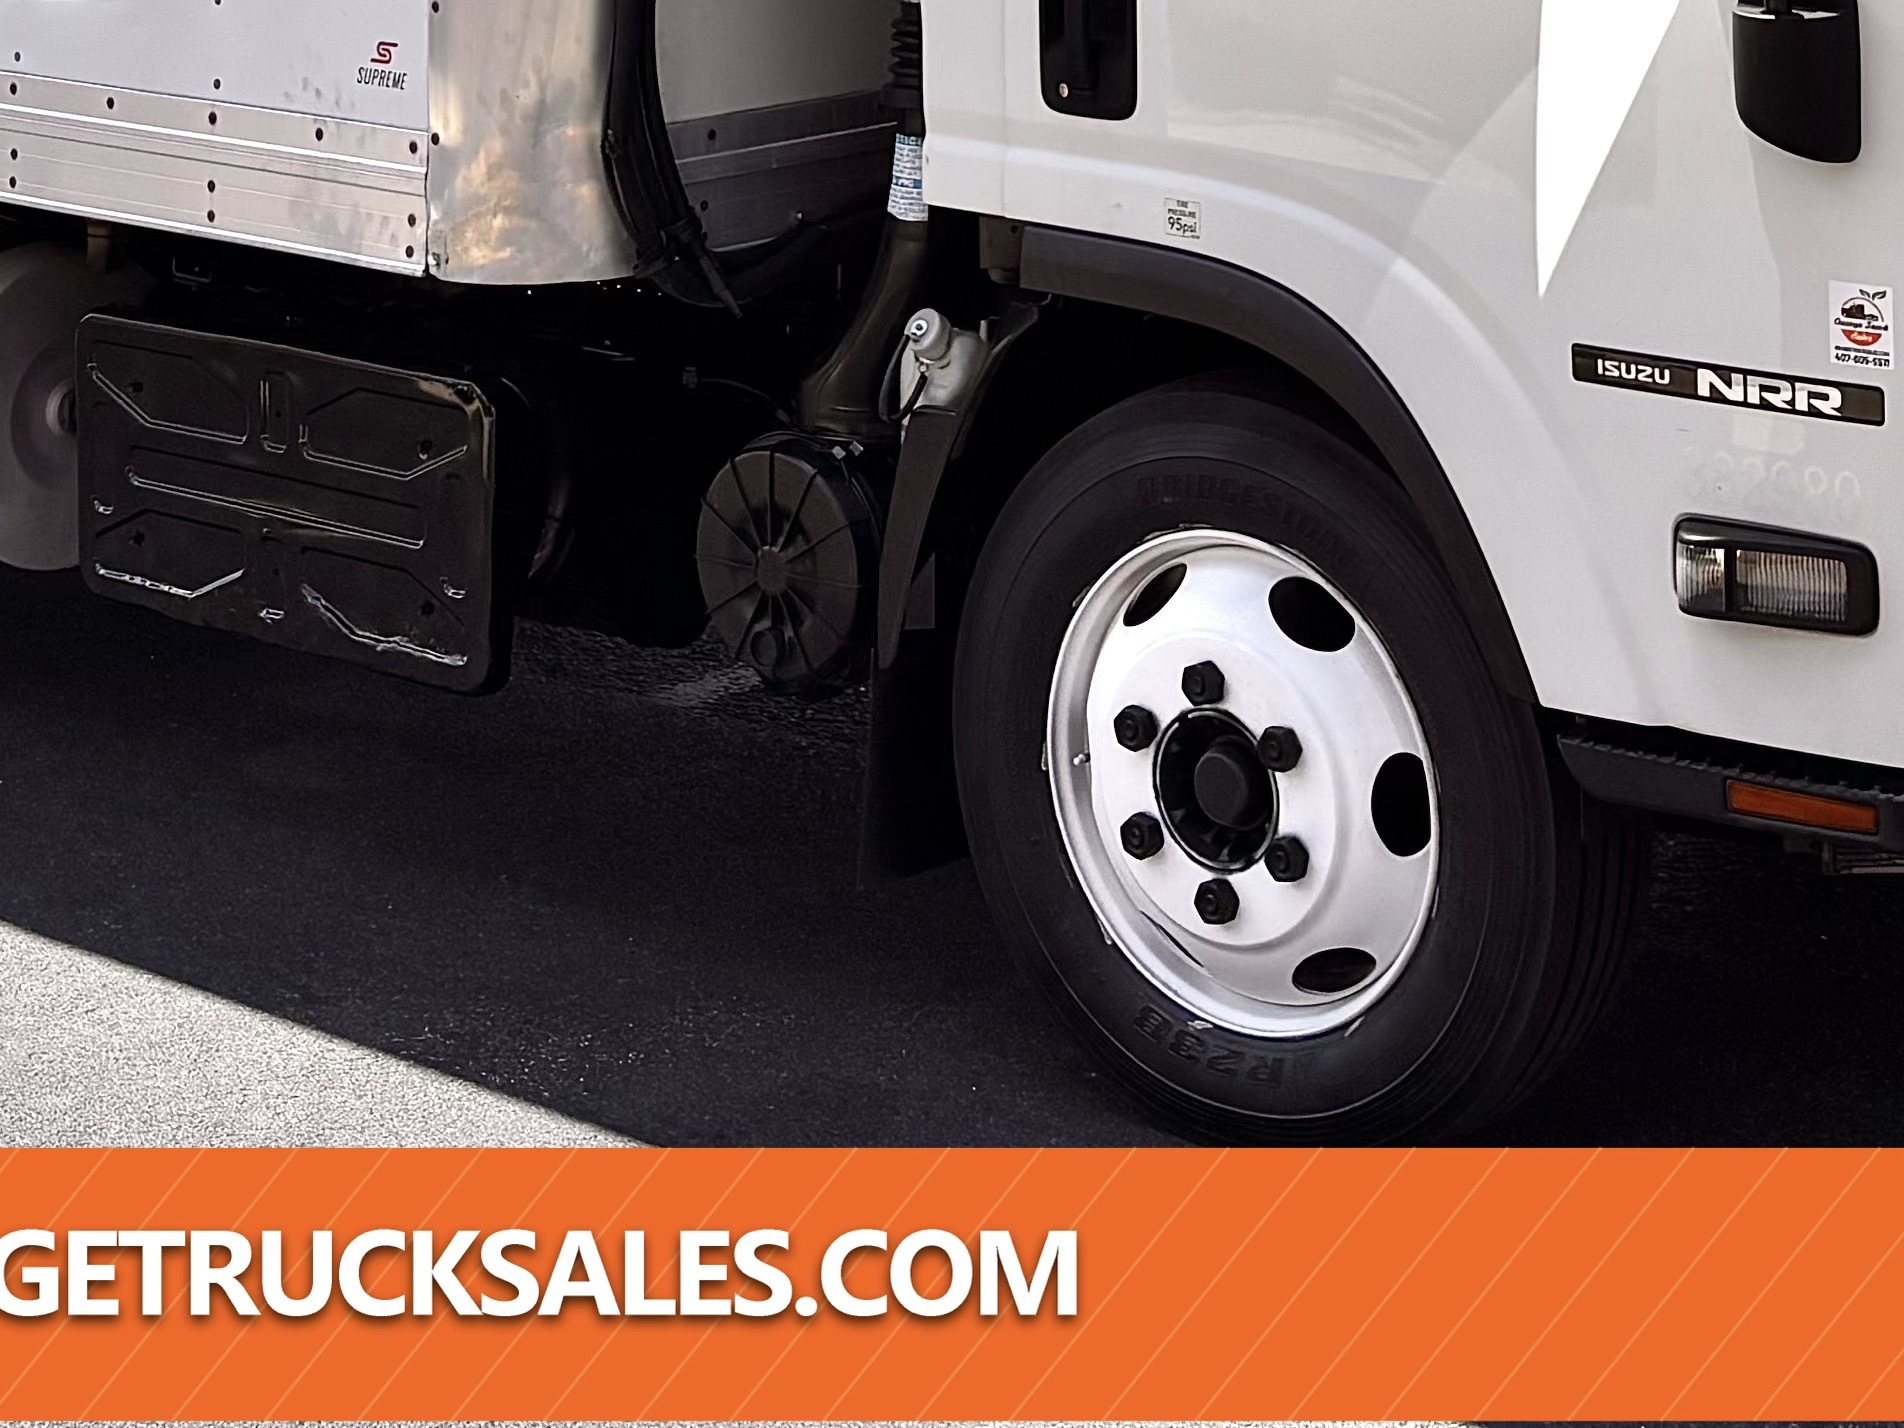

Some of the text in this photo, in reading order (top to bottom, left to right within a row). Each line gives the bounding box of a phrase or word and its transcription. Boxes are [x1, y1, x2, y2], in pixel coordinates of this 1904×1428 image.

[356, 66, 408, 91] SUPREME
[1596, 357, 1843, 416] ISUZU NRR
